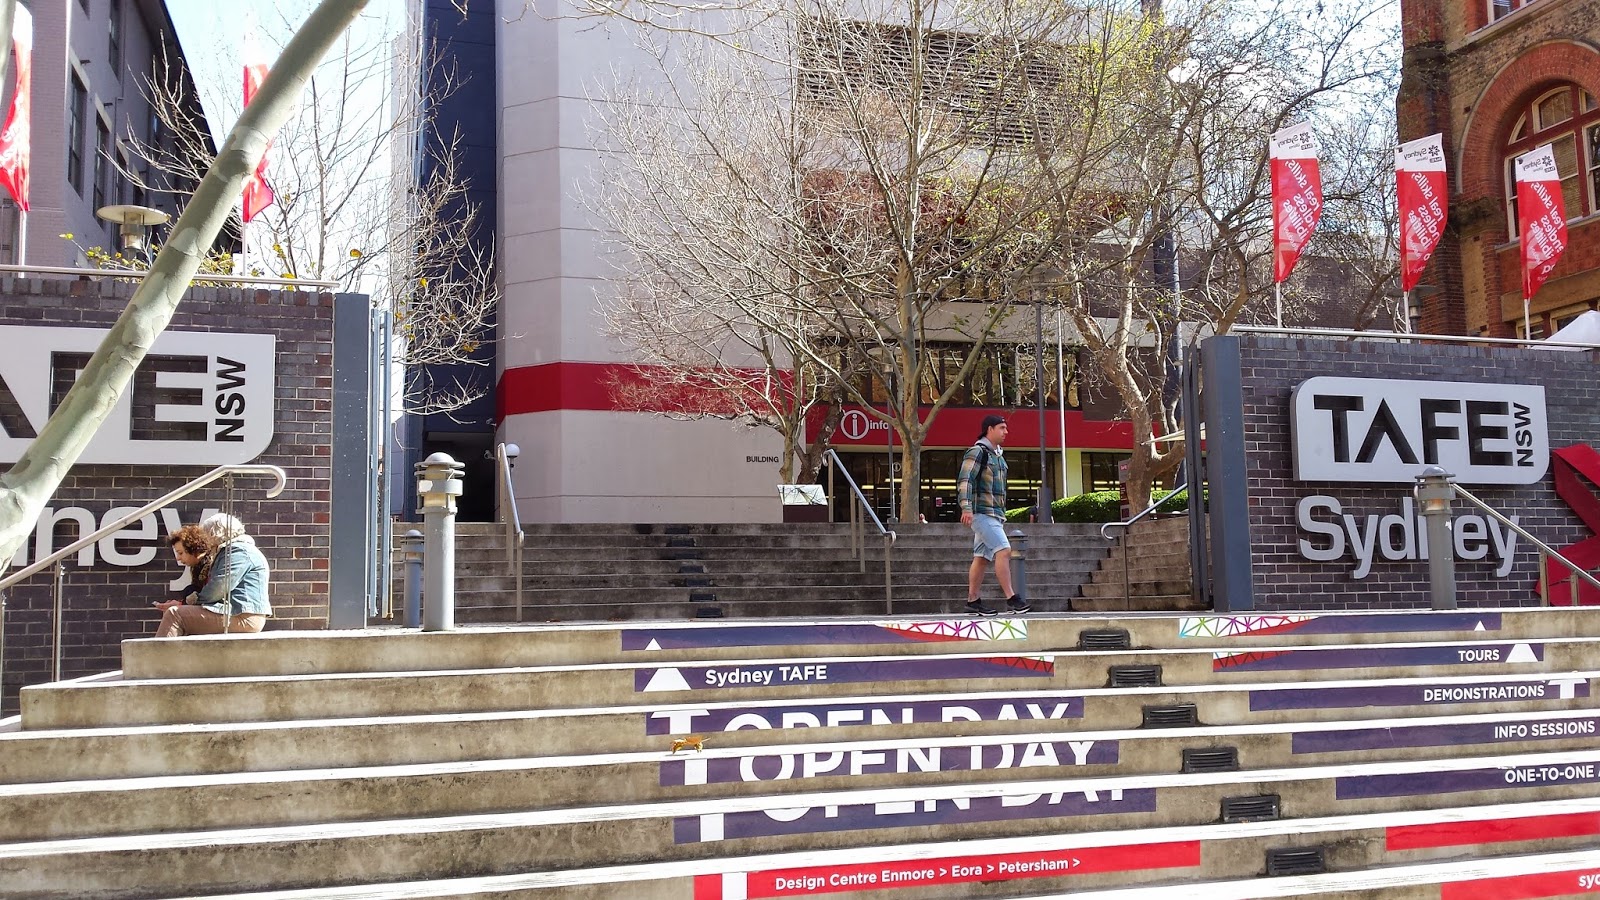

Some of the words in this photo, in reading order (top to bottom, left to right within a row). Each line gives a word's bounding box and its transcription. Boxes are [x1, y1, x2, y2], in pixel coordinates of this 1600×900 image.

[214, 356, 246, 442] NSW
[1313, 394, 1514, 467] TAFE
[1512, 401, 1534, 468] NSW
[1458, 649, 1500, 662] TOURS
[705, 668, 773, 687] Sydney
[779, 665, 827, 681] TAFE
[1424, 685, 1544, 701] DEMONSTRATIONS
[1495, 724, 1528, 738] INFO
[1531, 721, 1596, 736] SESSIONS
[1505, 765, 1595, 783] ONE-TO-ONE
[775, 875, 825, 890] Design
[830, 872, 877, 886] Centre
[881, 868, 935, 882] Enmore
[952, 864, 982, 877] Eora
[999, 859, 1068, 874] Petersham
